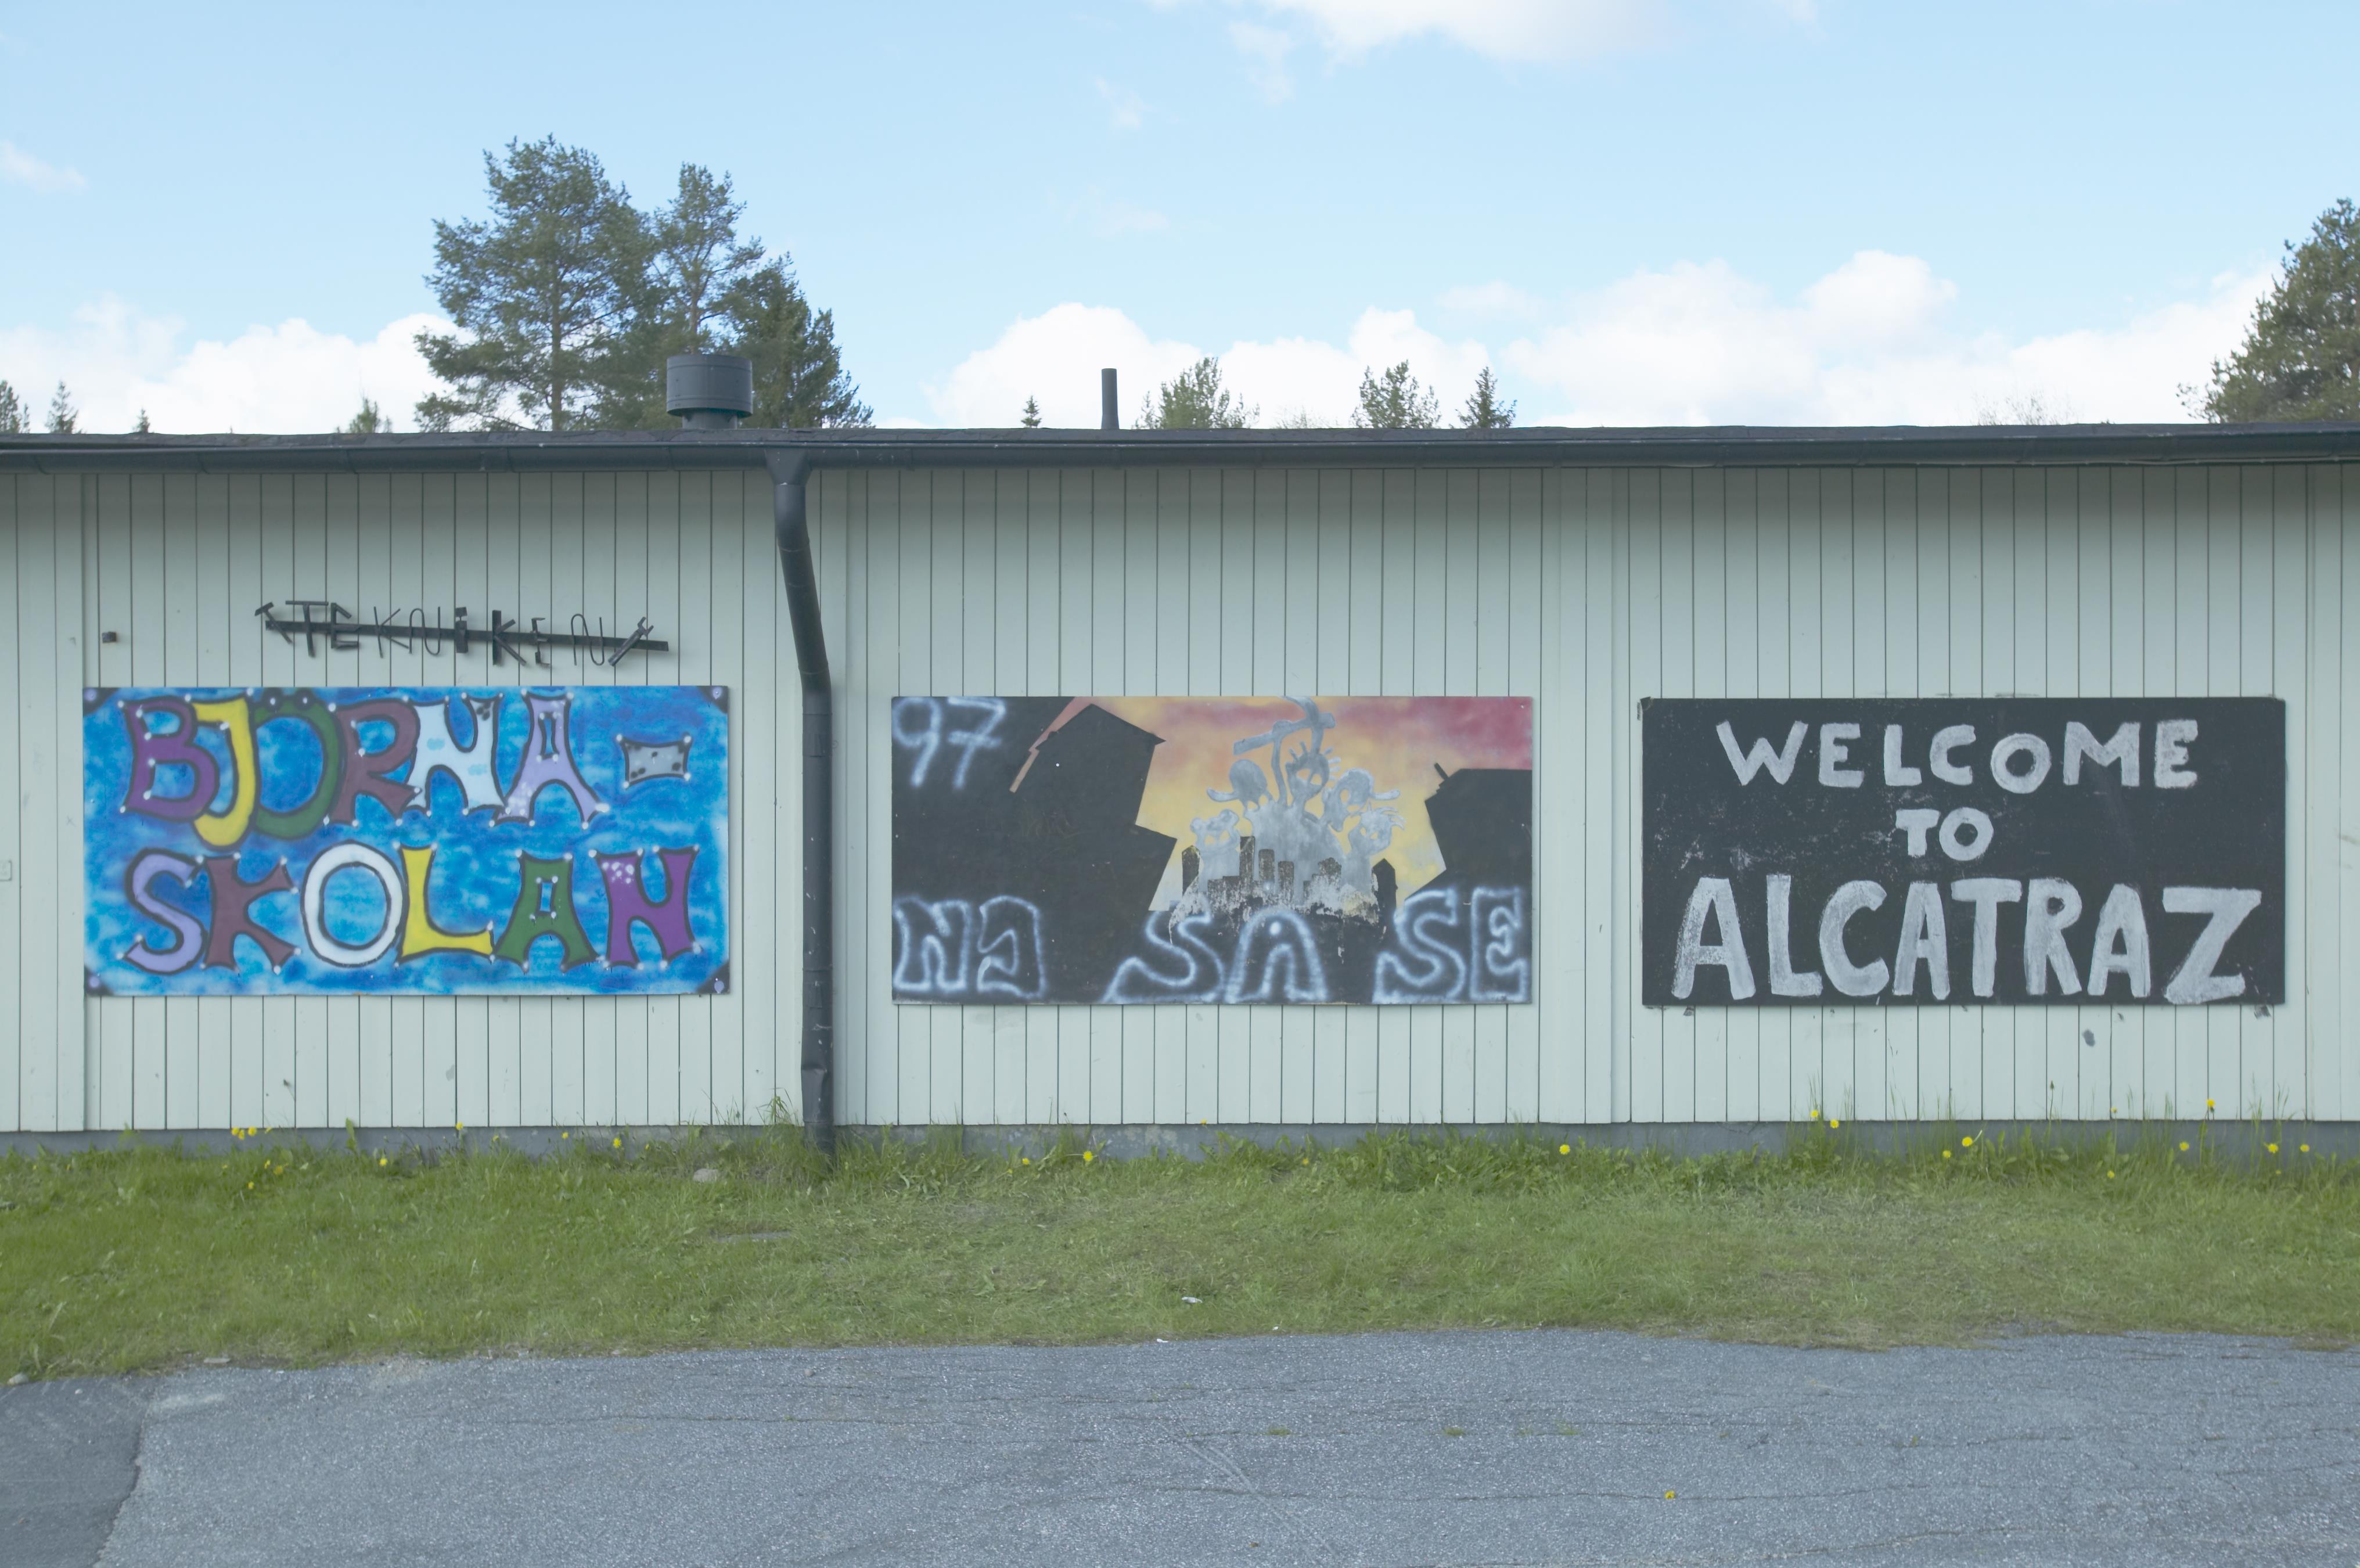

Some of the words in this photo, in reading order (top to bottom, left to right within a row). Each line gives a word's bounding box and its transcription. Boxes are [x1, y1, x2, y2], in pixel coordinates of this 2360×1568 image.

[891, 697, 1006, 789] 97
[1715, 719, 2199, 794] WELCOME
[1894, 807, 1995, 862] TO
[118, 839, 701, 976] SKOLAN
[1671, 874, 2262, 1004] ALCATRAZ
